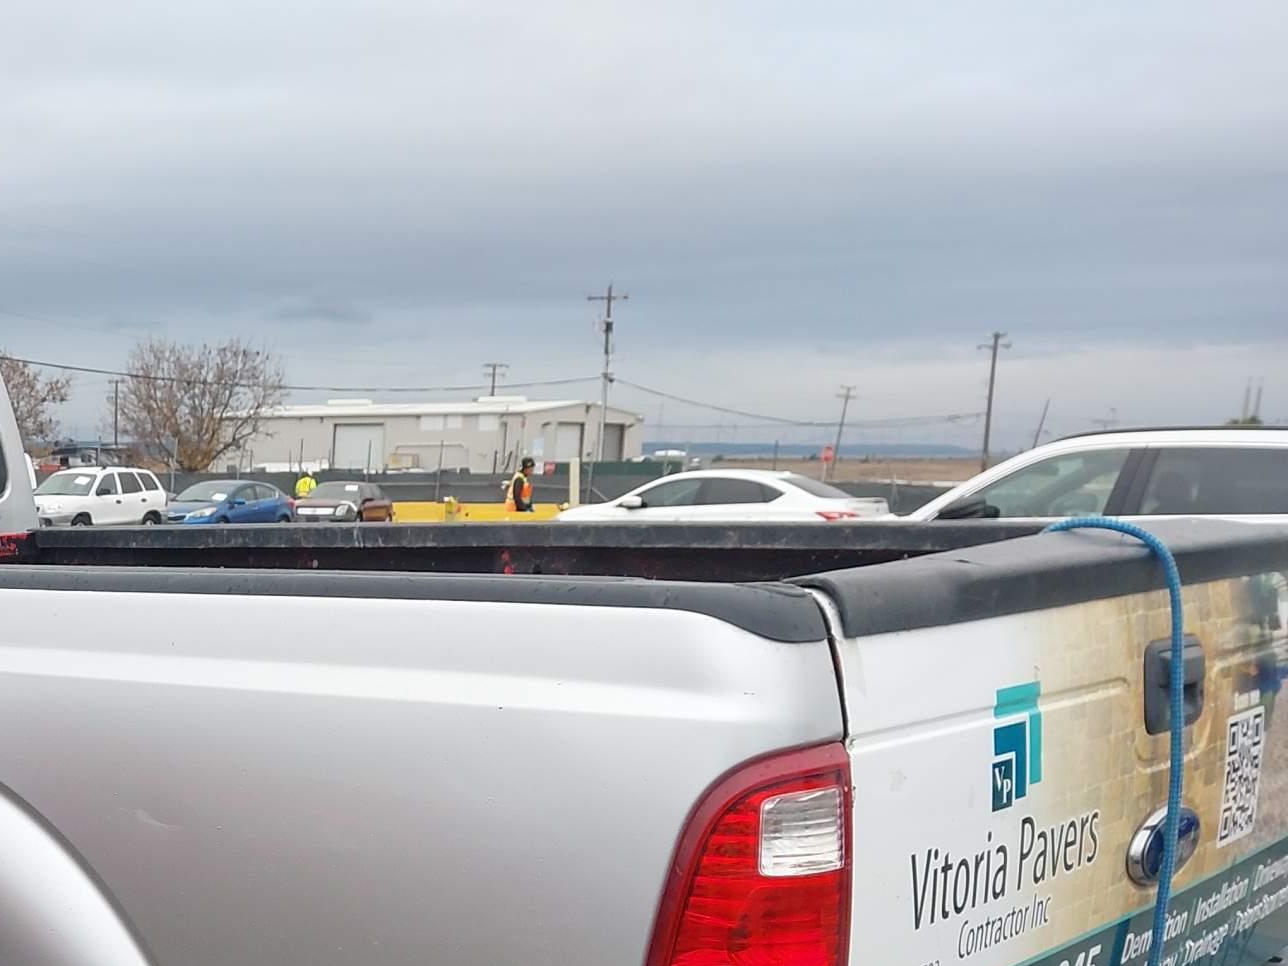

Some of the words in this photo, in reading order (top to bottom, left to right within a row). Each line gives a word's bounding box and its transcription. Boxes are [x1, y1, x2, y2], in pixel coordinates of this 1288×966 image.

[910, 831, 1009, 931] Vitoria
[1016, 810, 1101, 892] Pavers
[1194, 875, 1250, 926] Installation
[958, 902, 1031, 960] Contractor
[1031, 893, 1053, 930] Inc
